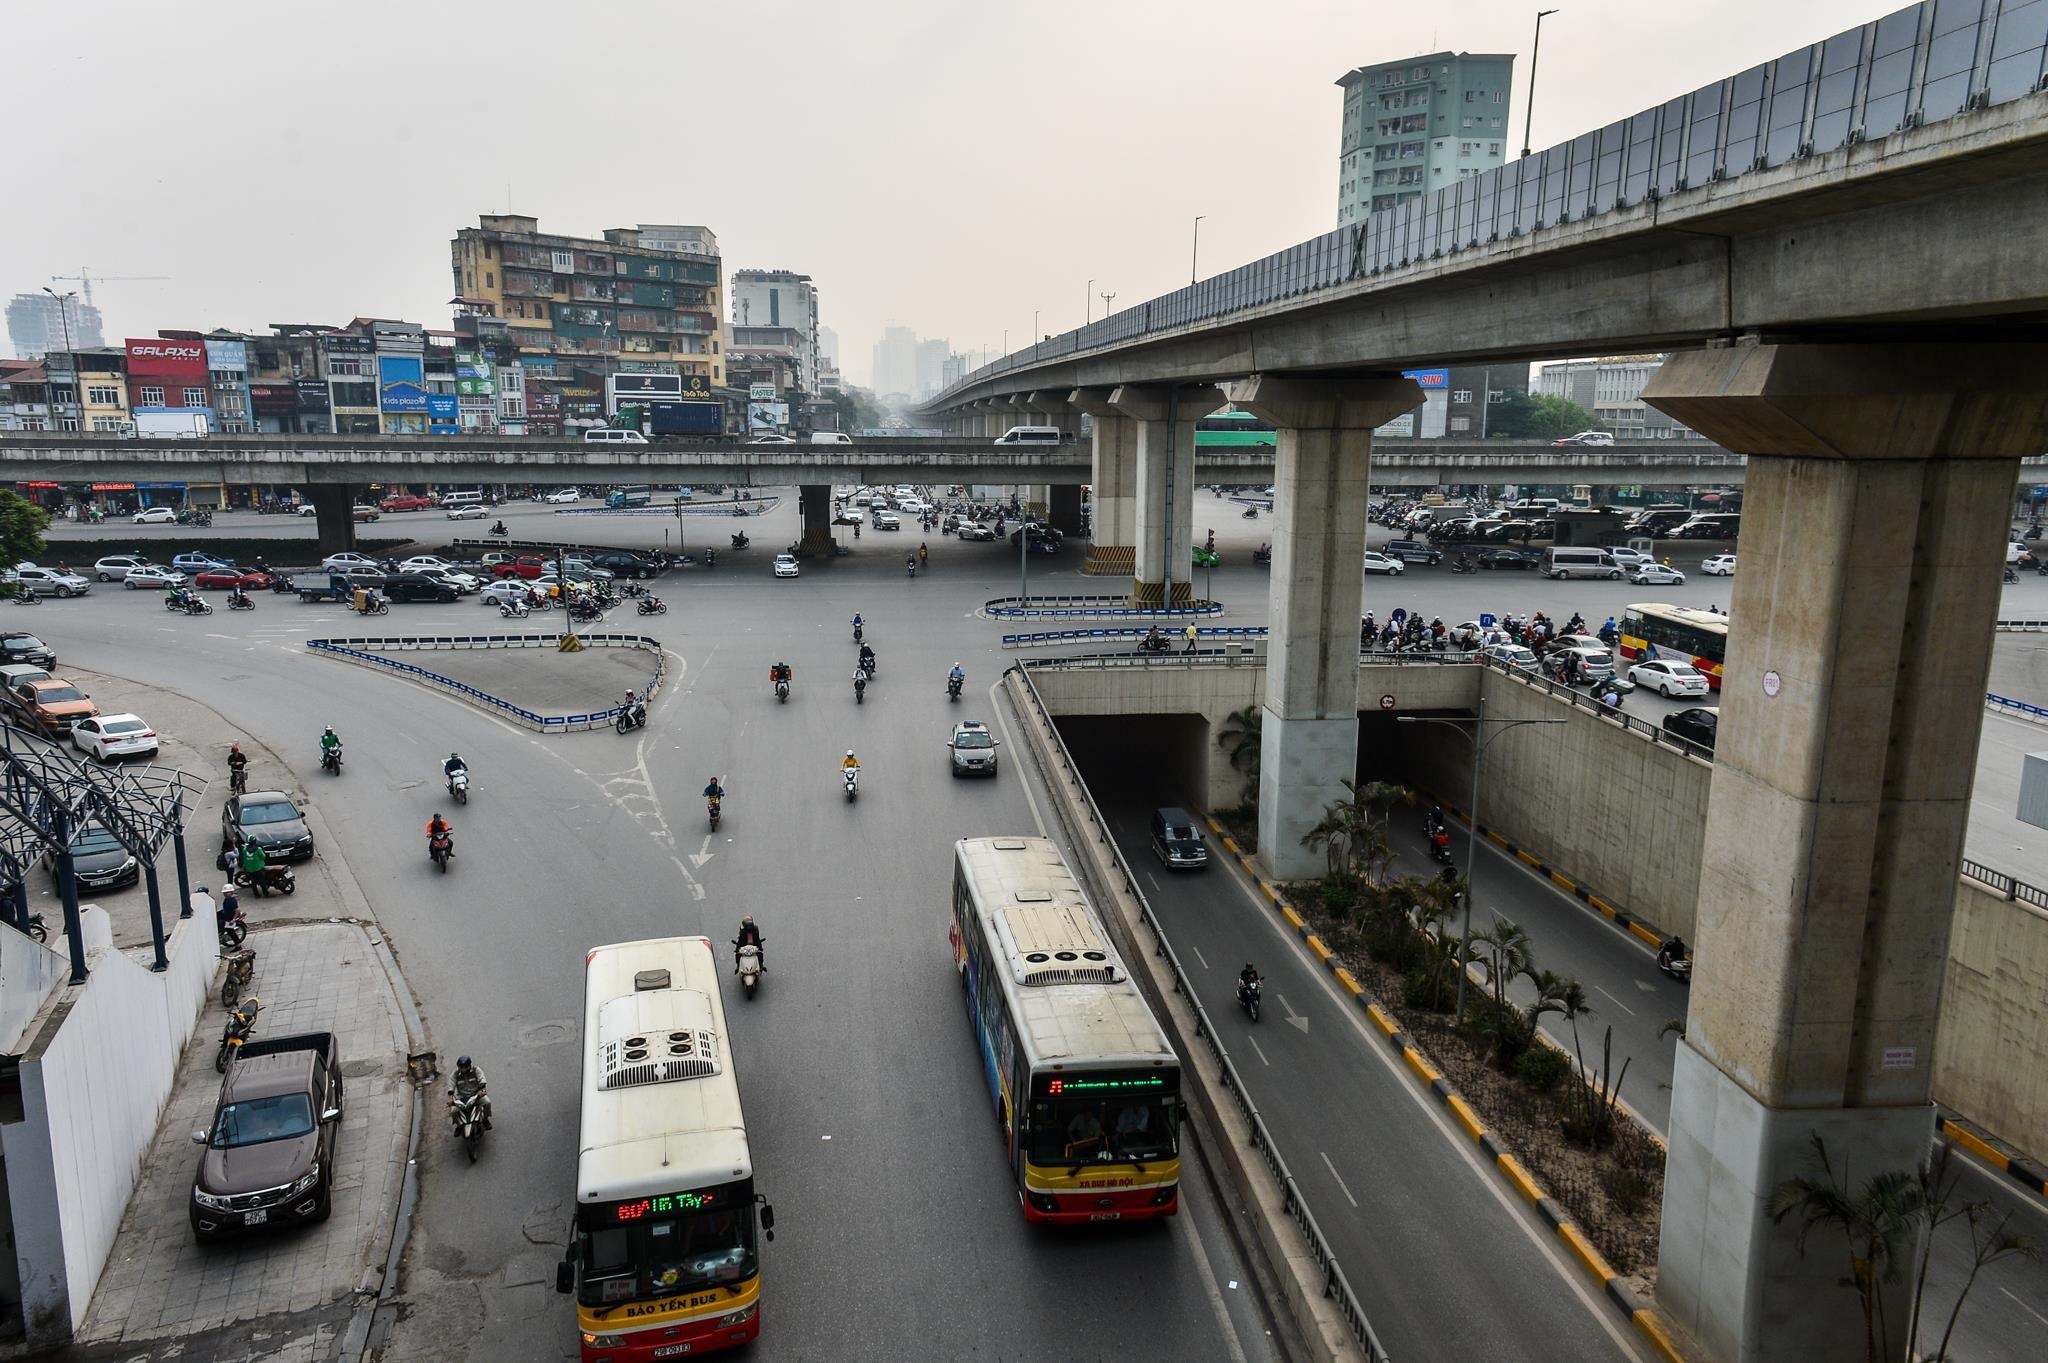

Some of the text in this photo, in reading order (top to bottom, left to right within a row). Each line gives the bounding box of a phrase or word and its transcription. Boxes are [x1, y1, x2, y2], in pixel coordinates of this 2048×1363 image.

[132, 346, 200, 357] GALAXY
[1422, 374, 1443, 385] SINO
[383, 396, 420, 405] Kids plaza
[676, 1194, 702, 1208] Tây
[627, 1294, 717, 1317] BẢO YẾN BUS
